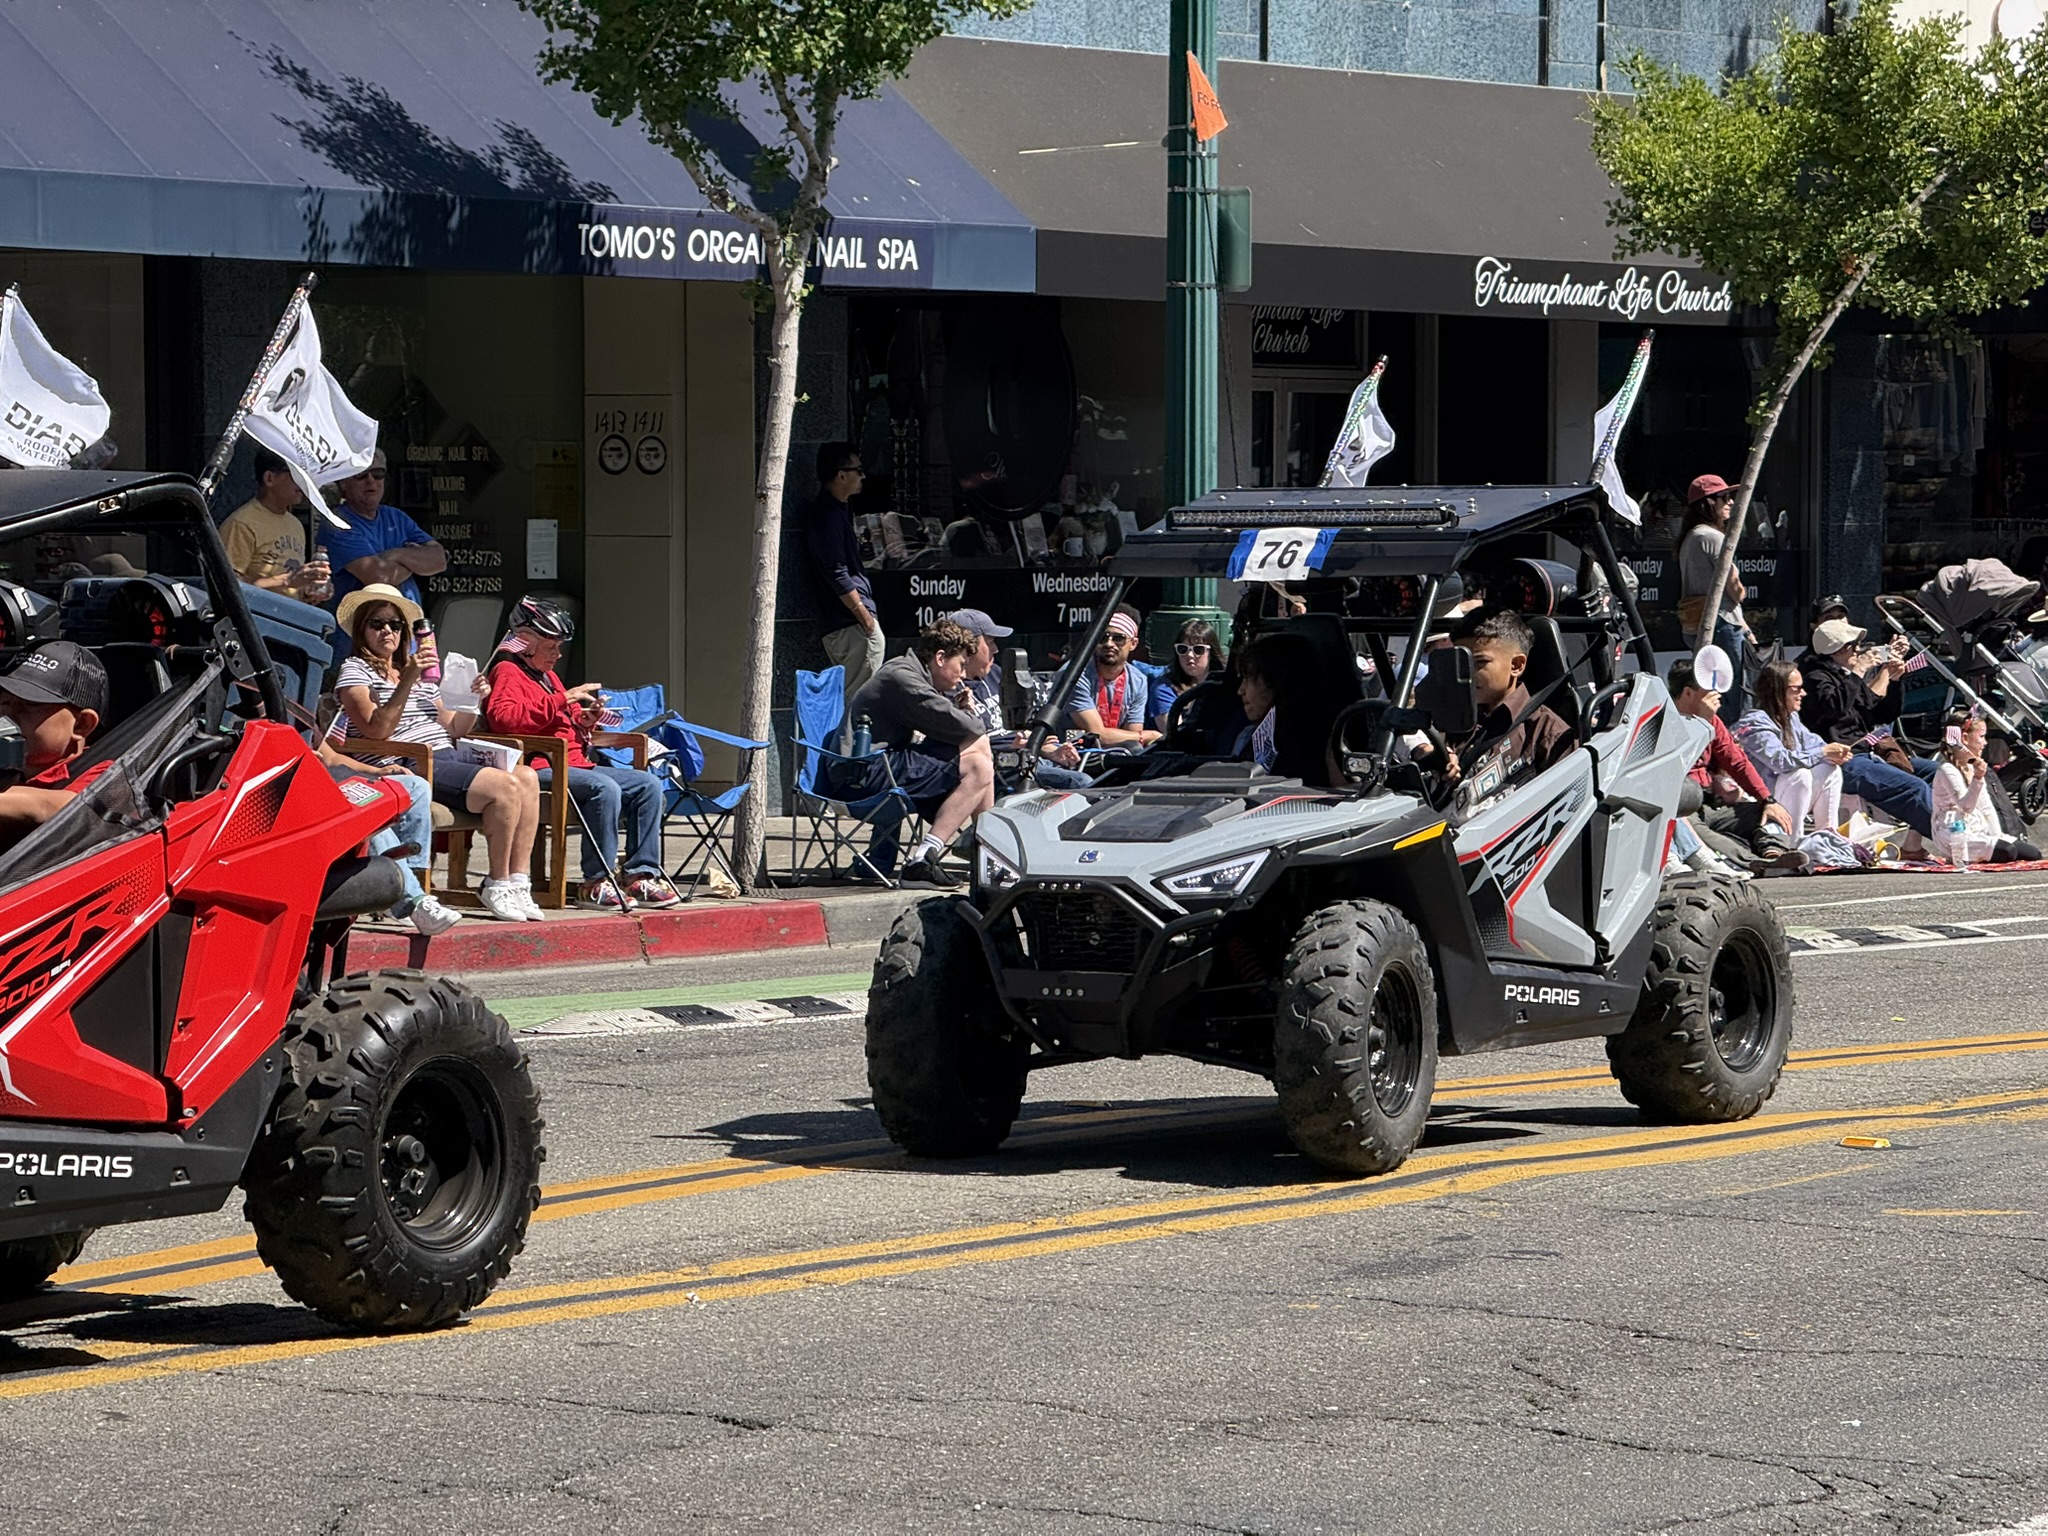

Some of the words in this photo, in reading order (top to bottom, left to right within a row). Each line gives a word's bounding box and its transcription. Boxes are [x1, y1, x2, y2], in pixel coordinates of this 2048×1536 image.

[578, 223, 676, 261] TOMO'S
[688, 228, 785, 265] ORGA
[816, 236, 867, 269] NAIL
[877, 237, 919, 271] SPA
[1475, 256, 1609, 315] Triumphant
[1608, 266, 1653, 321] Life
[1655, 270, 1733, 315] Church
[1253, 323, 1311, 354] Church
[594, 410, 627, 434] 1413
[632, 411, 664, 434] 1411
[406, 446, 443, 461] ORGANIC
[448, 446, 468, 461] NAIL
[471, 446, 490, 461] SPA
[432, 476, 466, 491] WAXING
[439, 500, 459, 516] NAIL
[431, 524, 472, 540] MASSAGE
[1257, 540, 1303, 570] 76
[909, 575, 966, 600] Sunday
[1032, 572, 1115, 593] Wednesday
[1640, 586, 1659, 601] am
[914, 606, 934, 628] 10
[1057, 602, 1067, 623] 7
[1069, 606, 1092, 628] pm
[1467, 789, 1578, 896] RZR
[1502, 854, 1536, 891] 200
[0, 885, 133, 993] ZR
[1504, 984, 1581, 1006] POLARIS
[0, 1152, 134, 1178] POLARIS
